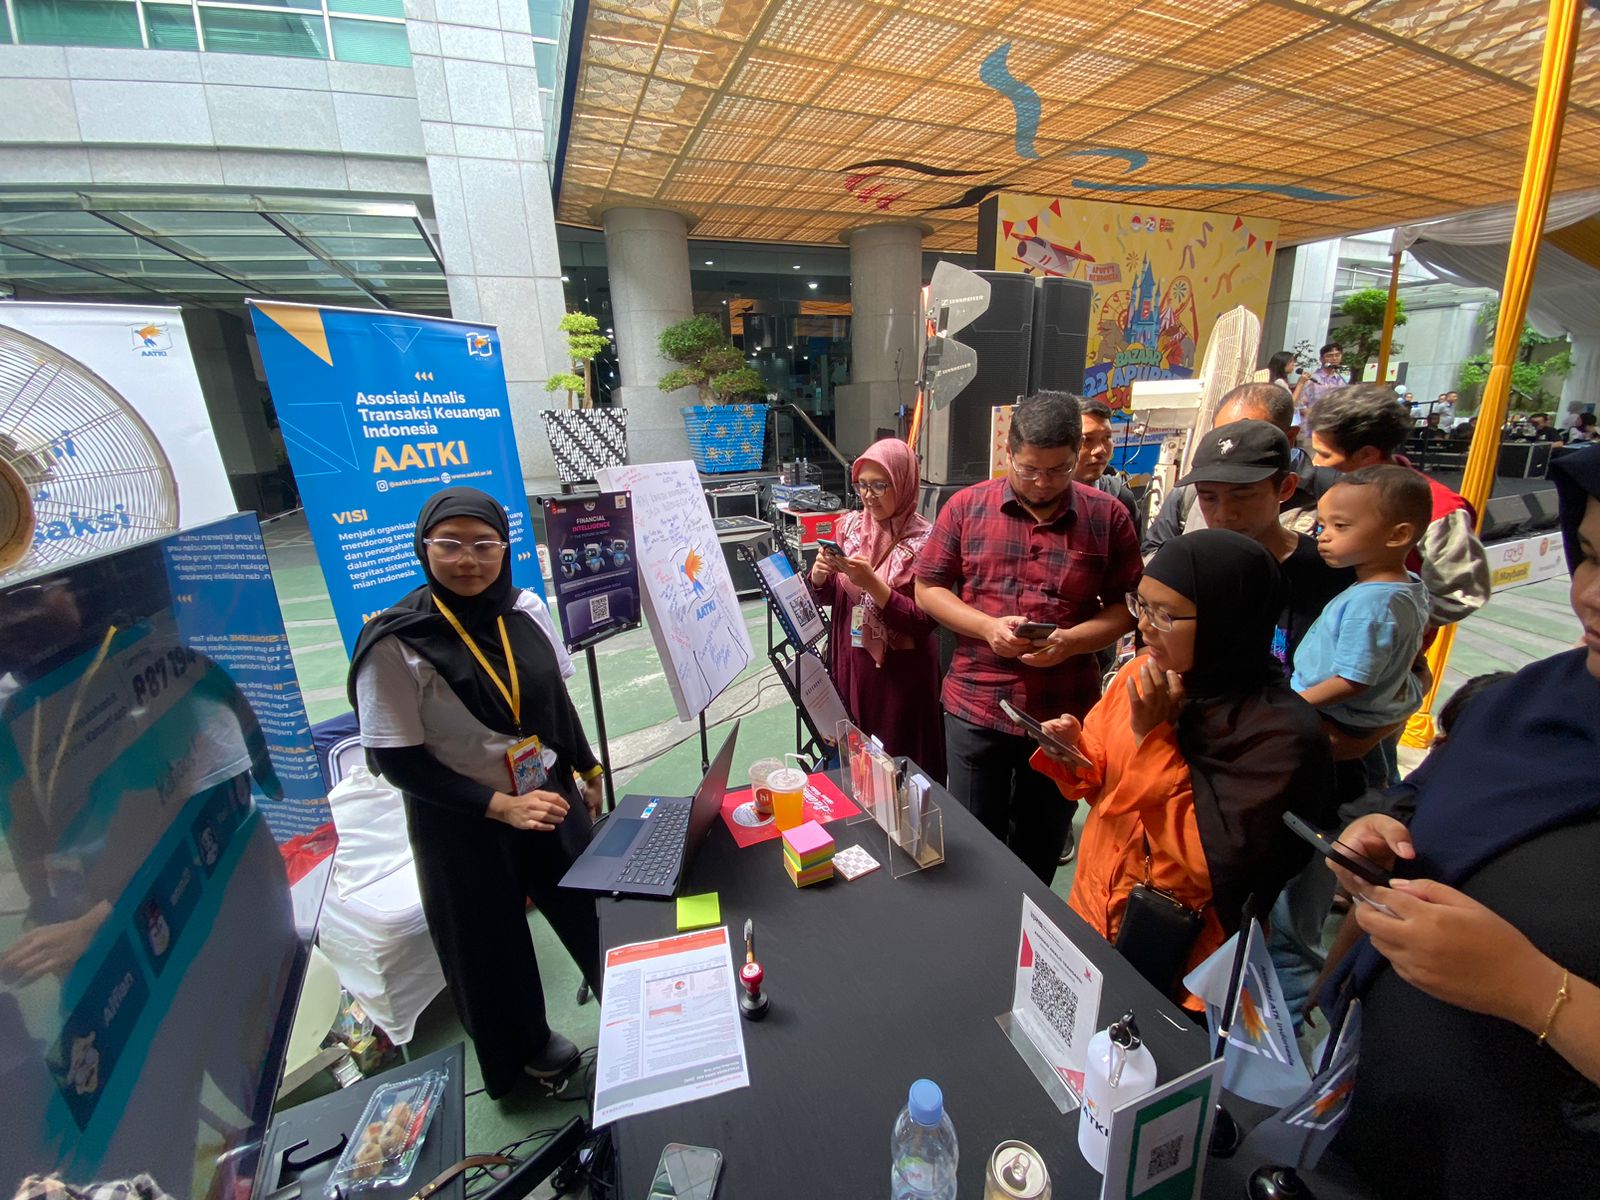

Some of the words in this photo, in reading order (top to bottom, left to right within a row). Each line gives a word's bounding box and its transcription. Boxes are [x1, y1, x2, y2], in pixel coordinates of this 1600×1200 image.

[1116, 348, 1162, 368] BAZAAR
[1084, 372, 1108, 397] 22
[355, 390, 420, 406] Asosiasi
[422, 391, 466, 404] Analis
[358, 406, 432, 422] Transaksi
[435, 406, 500, 420] Keuangan
[362, 422, 438, 438] Indonesia
[373, 440, 469, 474] AATKI
[332, 508, 368, 524] VISI
[576, 516, 606, 524] FINANCIAL
[338, 527, 376, 541] Menjadi
[376, 520, 416, 535] organisasi
[572, 522, 610, 533] INTELLIGENCE
[342, 536, 394, 550] mendorong
[344, 550, 363, 561] dan
[364, 542, 414, 558] pencegahan
[346, 558, 377, 570] dalam
[378, 550, 415, 564] menduku
[349, 566, 384, 580] tegritas
[385, 562, 410, 572] sistem
[352, 578, 377, 590] mian
[378, 570, 418, 584] Indonesia.
[696, 600, 716, 622] AATKI
[759, 793, 768, 802] hi
[1083, 1106, 1109, 1137] ATKI
